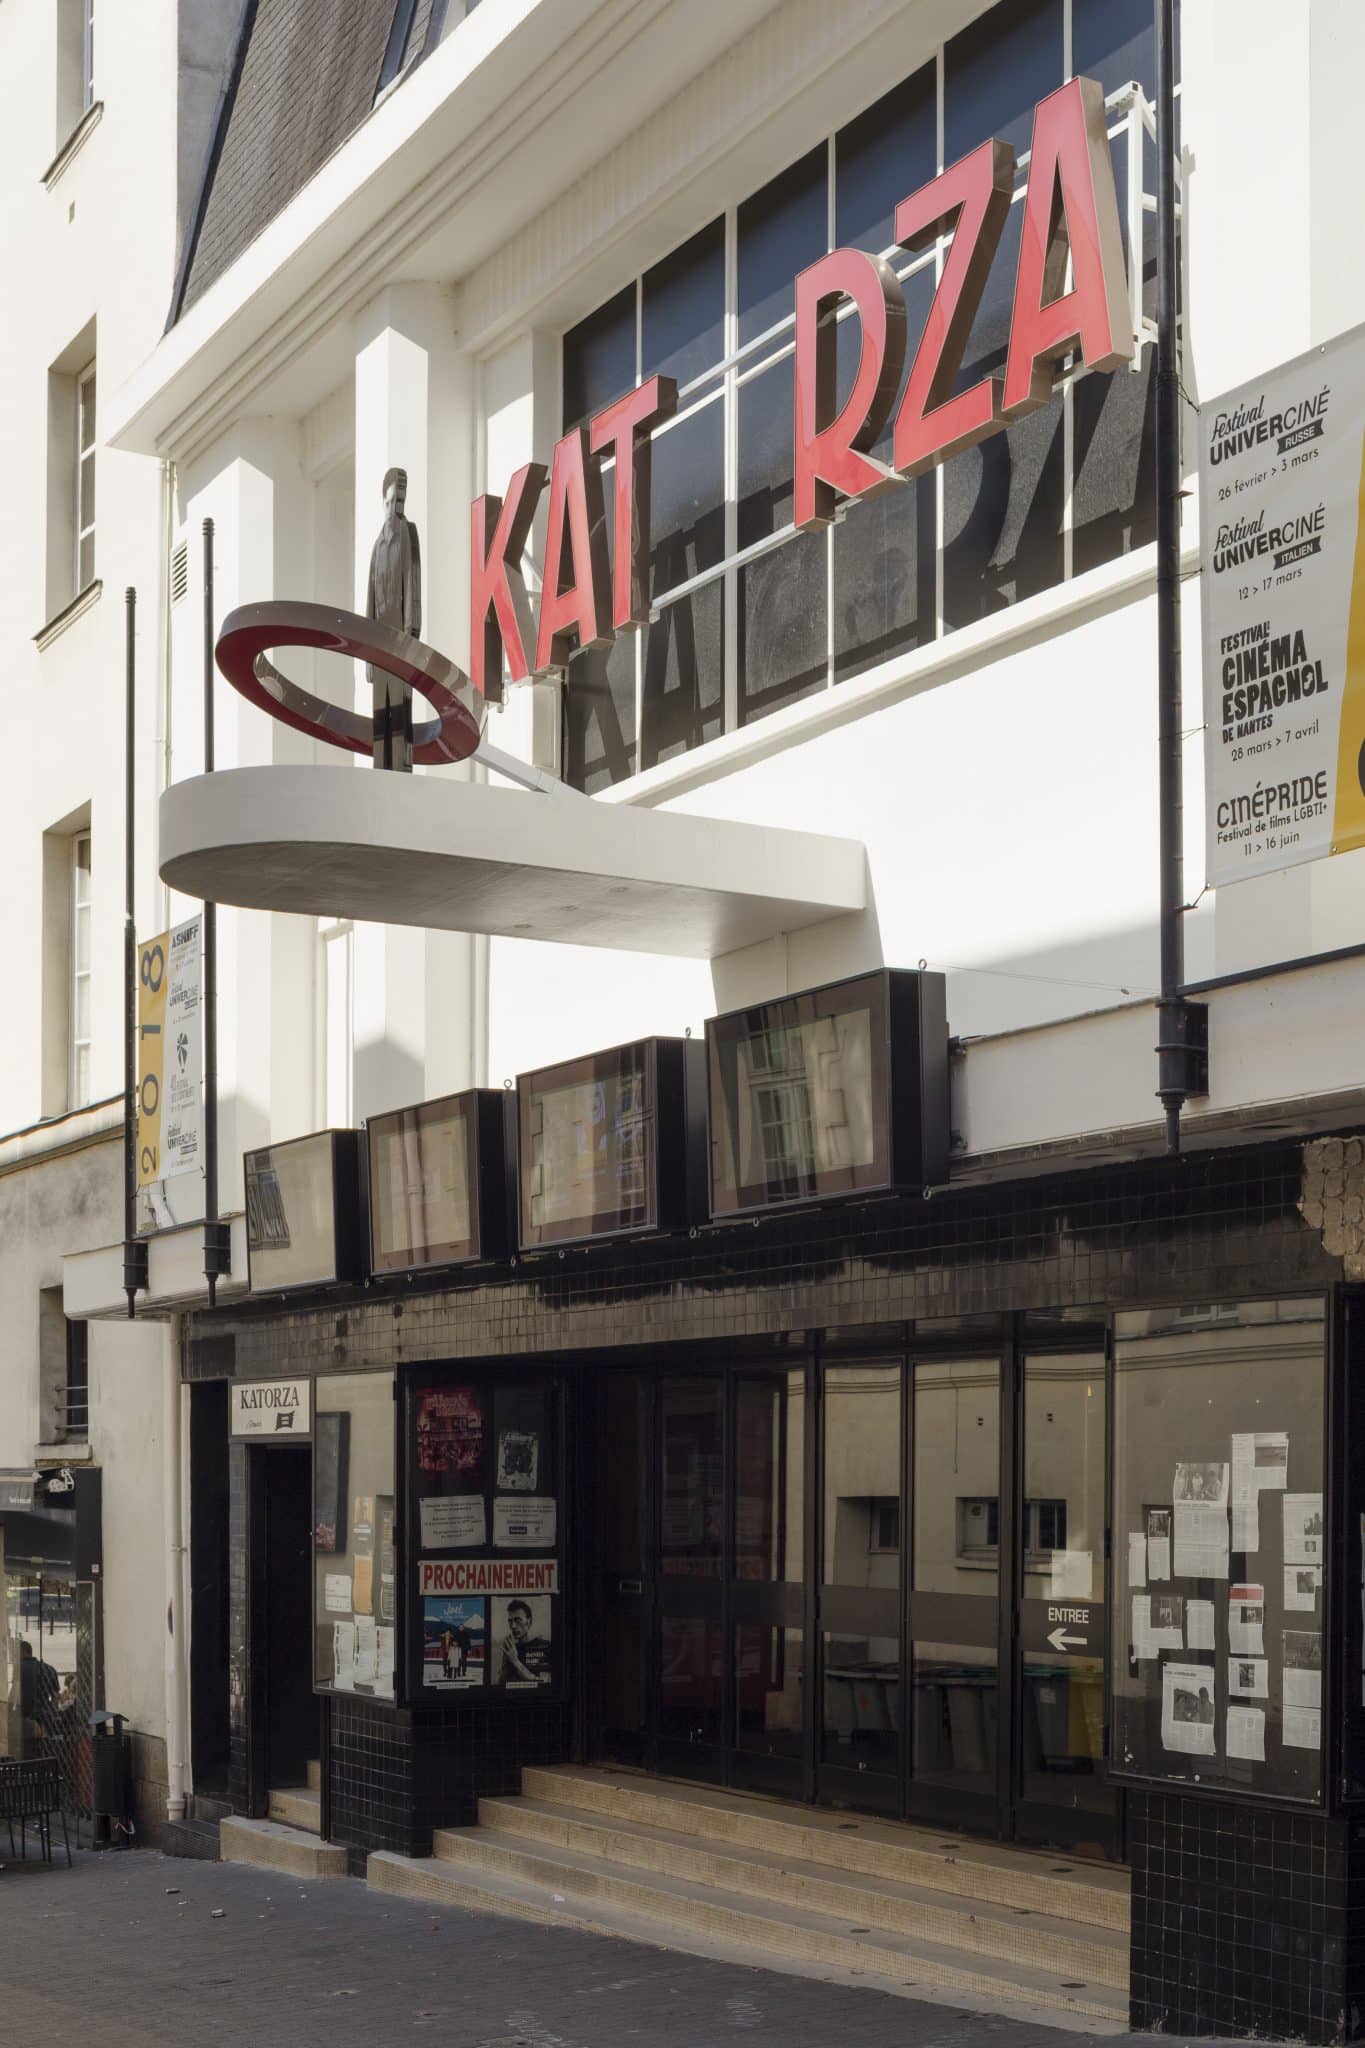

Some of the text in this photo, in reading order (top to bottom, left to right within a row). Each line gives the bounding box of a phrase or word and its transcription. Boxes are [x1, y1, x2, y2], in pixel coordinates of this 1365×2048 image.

[1210, 385, 1330, 466] UNIVERCINÉ
[1211, 395, 1264, 442] Festival
[1285, 426, 1315, 448] RUSSE
[1218, 486, 1231, 501] 26
[1234, 472, 1267, 493] février
[1281, 459, 1287, 471] 3
[1291, 449, 1319, 467] mars
[1213, 502, 1325, 573] UNIVERCINÉ
[1214, 510, 1264, 552] Festival
[1281, 543, 1313, 564] ITALIEN
[1239, 587, 1248, 600] 12
[1263, 577, 1272, 591] 17
[1276, 568, 1302, 586] mars
[1222, 629, 1307, 690] CINÉMA
[1223, 660, 1328, 726] ESPAGNOL
[1222, 714, 1273, 744] DE NANTES
[1231, 747, 1243, 761] 28
[1247, 740, 1272, 756] mars
[1285, 730, 1291, 743] 7
[1295, 719, 1319, 740] avril
[1217, 770, 1327, 828] CINÉPRIDE
[1217, 801, 1327, 844] Festival de films LGBTI+
[1244, 843, 1251, 856] 11
[1266, 837, 1276, 850] 16
[1280, 832, 1300, 848] juin
[240, 1386, 300, 1409] KATORZA
[424, 1563, 555, 1590] PROCHAINEMENT
[1048, 1607, 1089, 1624] ENTREE
